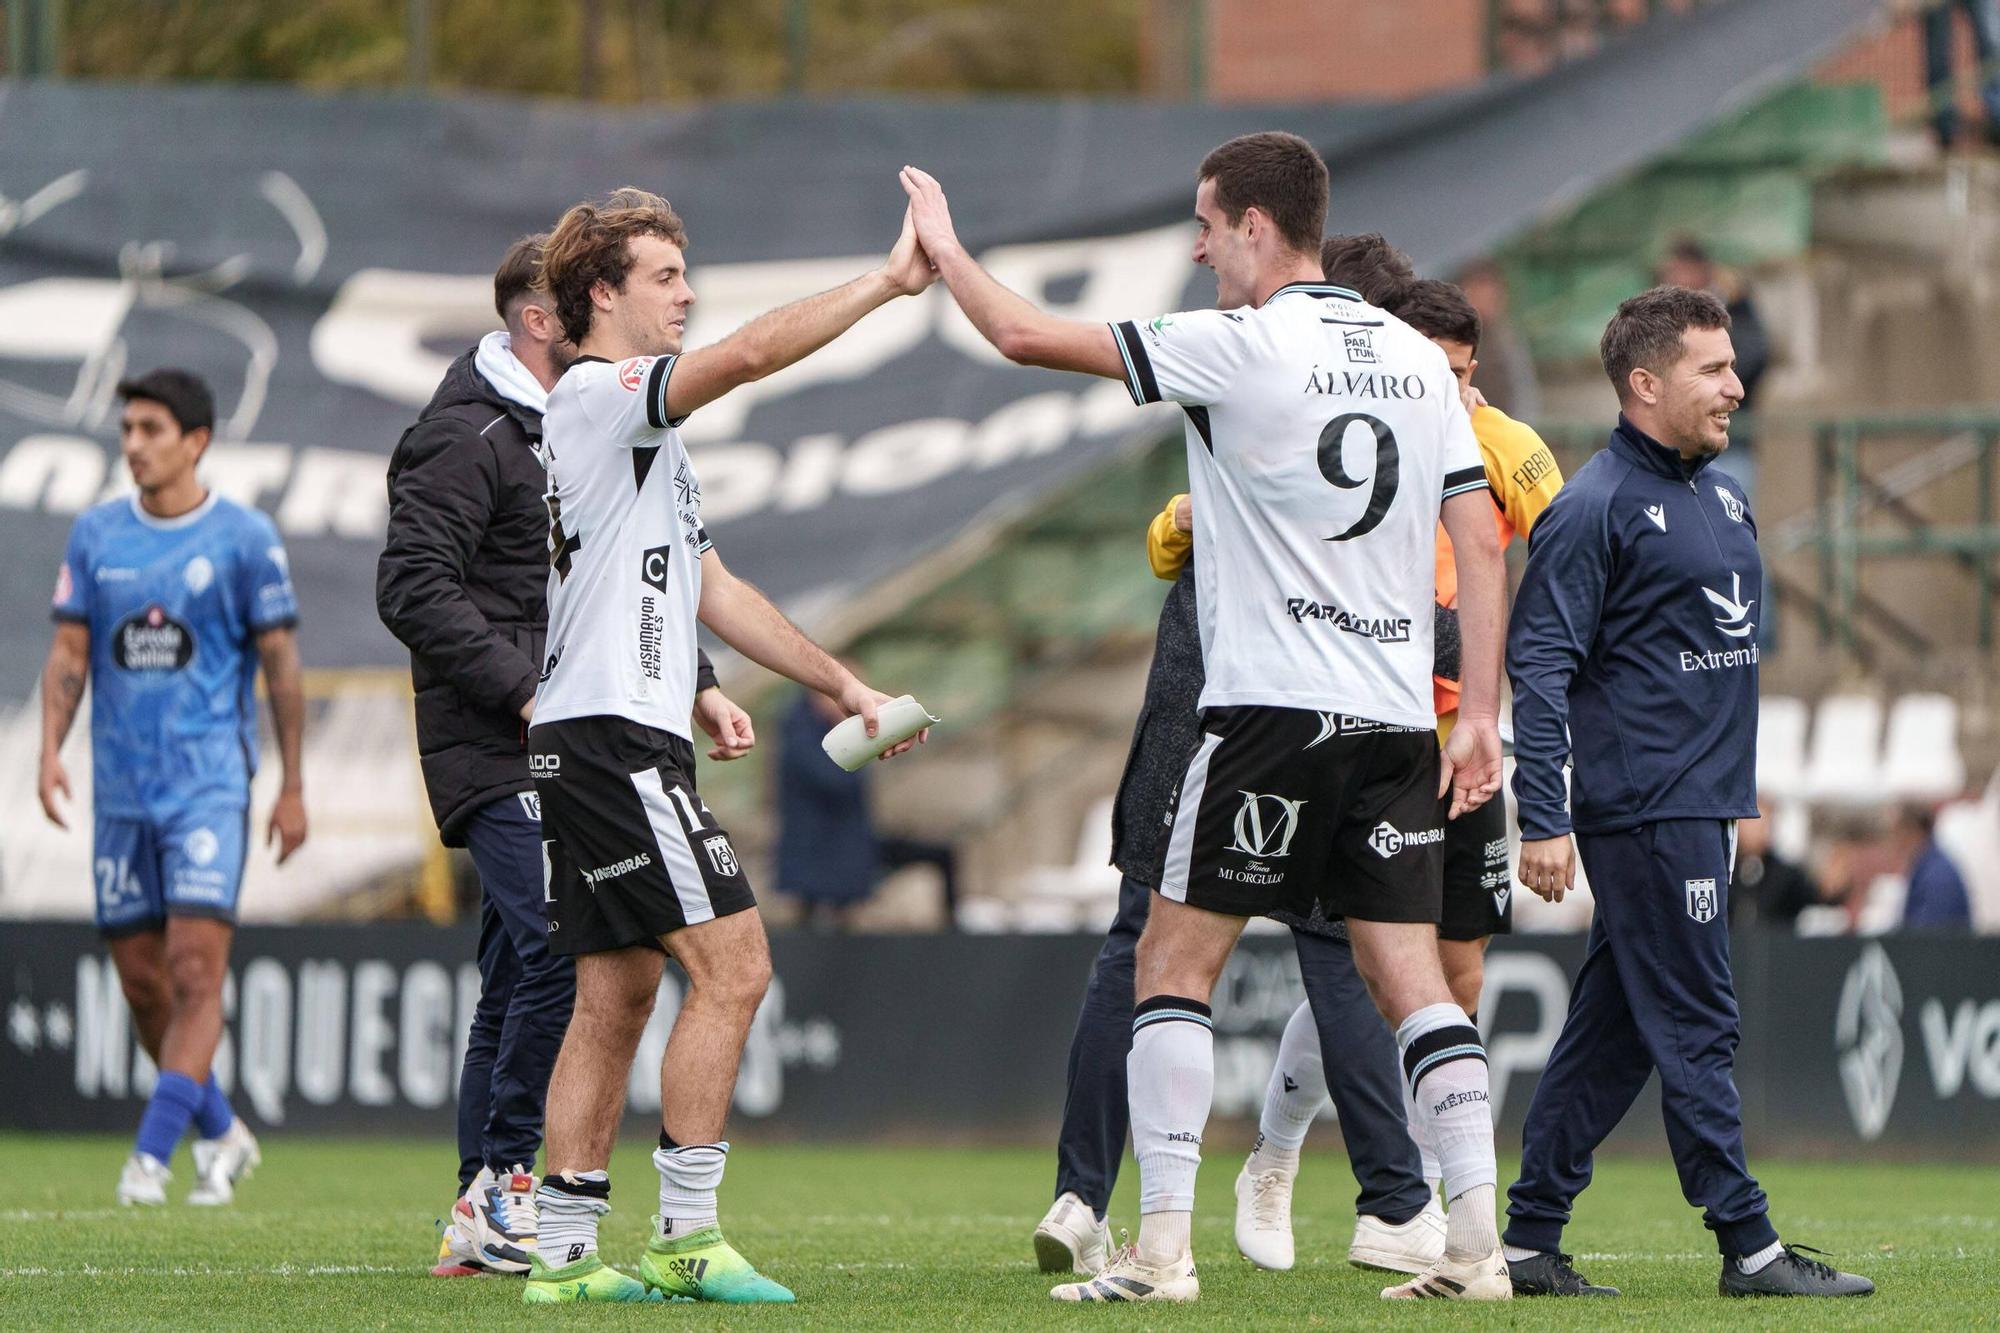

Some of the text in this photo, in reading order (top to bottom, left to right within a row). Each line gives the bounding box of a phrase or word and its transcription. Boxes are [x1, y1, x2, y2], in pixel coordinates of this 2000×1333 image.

[1344, 338, 1367, 348] PAR
[1353, 348, 1375, 358] TUN
[1304, 364, 1425, 399] ÁLVARO
[1317, 412, 1400, 542] 9
[640, 596, 655, 678] CASAMAYOR
[652, 614, 664, 681] PERFILES
[1374, 827, 1401, 853] FG
[96, 856, 143, 905] 24
[1218, 867, 1234, 880] MI
[668, 1260, 704, 1300] adidas
